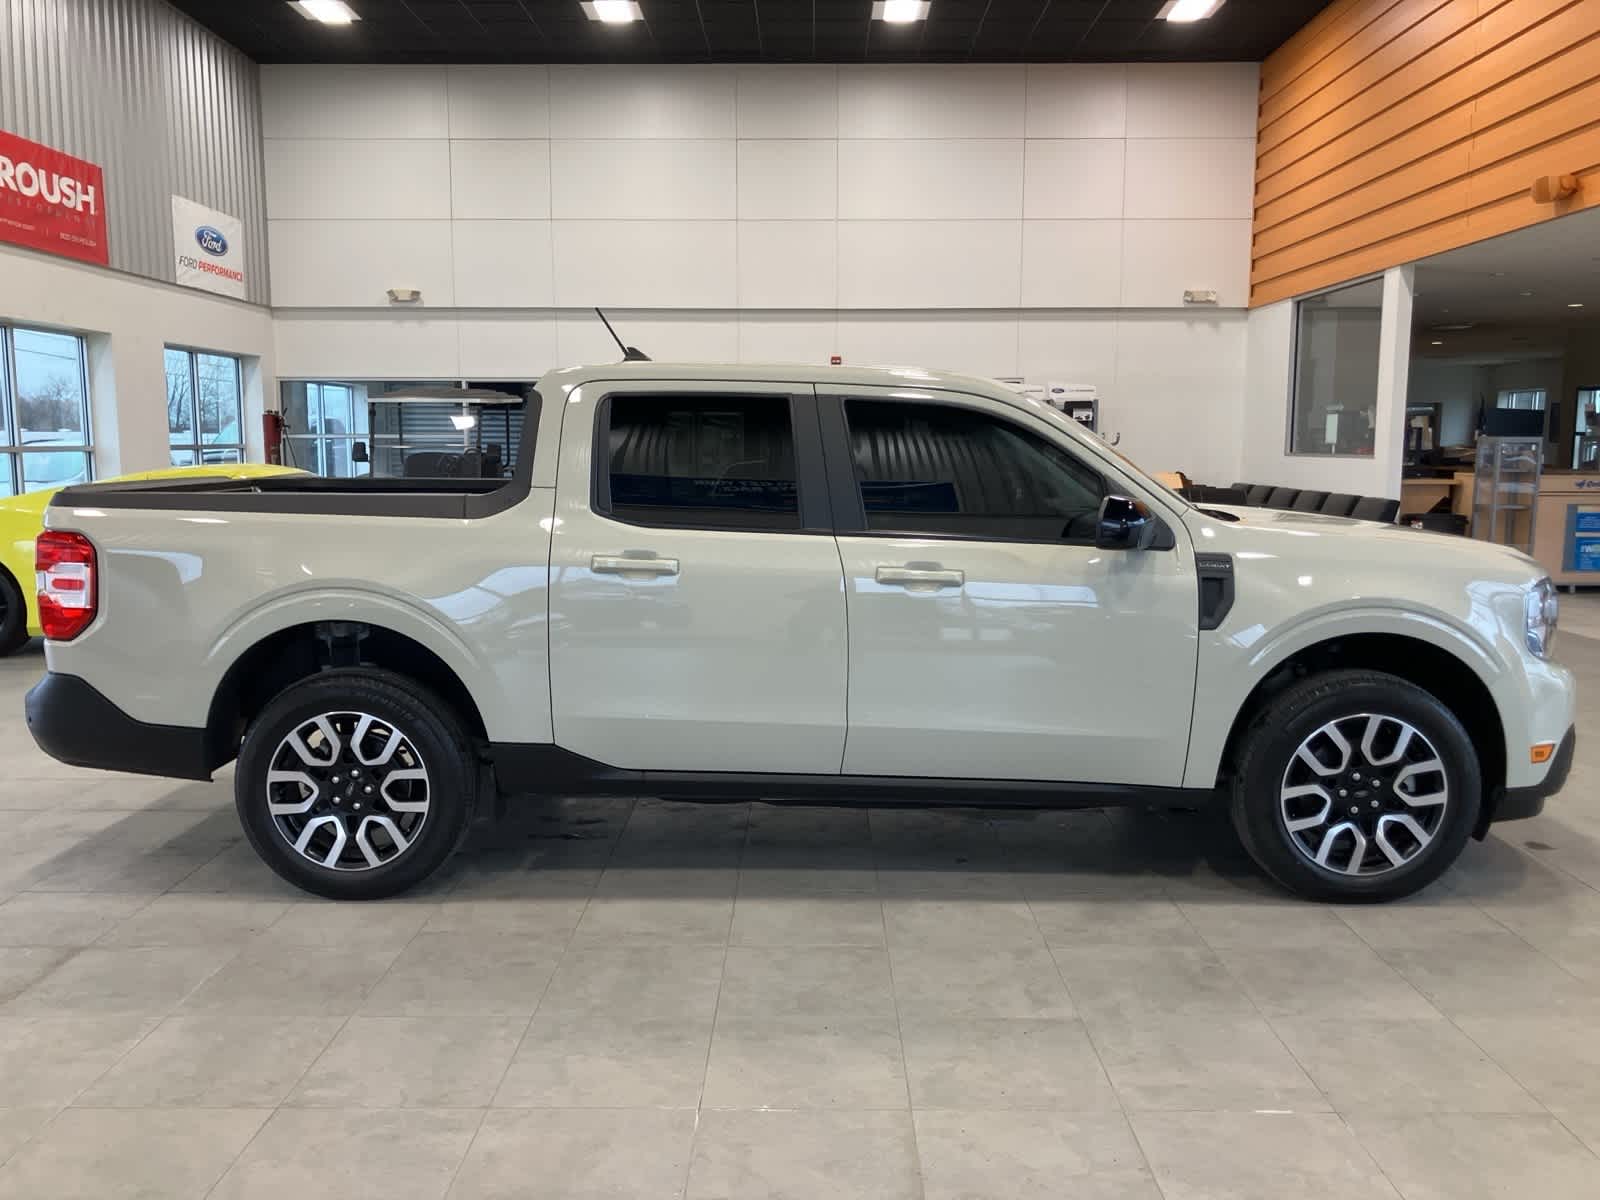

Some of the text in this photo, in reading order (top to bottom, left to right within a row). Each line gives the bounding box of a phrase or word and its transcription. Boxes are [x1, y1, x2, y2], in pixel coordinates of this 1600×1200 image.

[0, 154, 95, 216] ROUSH
[201, 230, 222, 252] Ford
[179, 255, 198, 270] FORD
